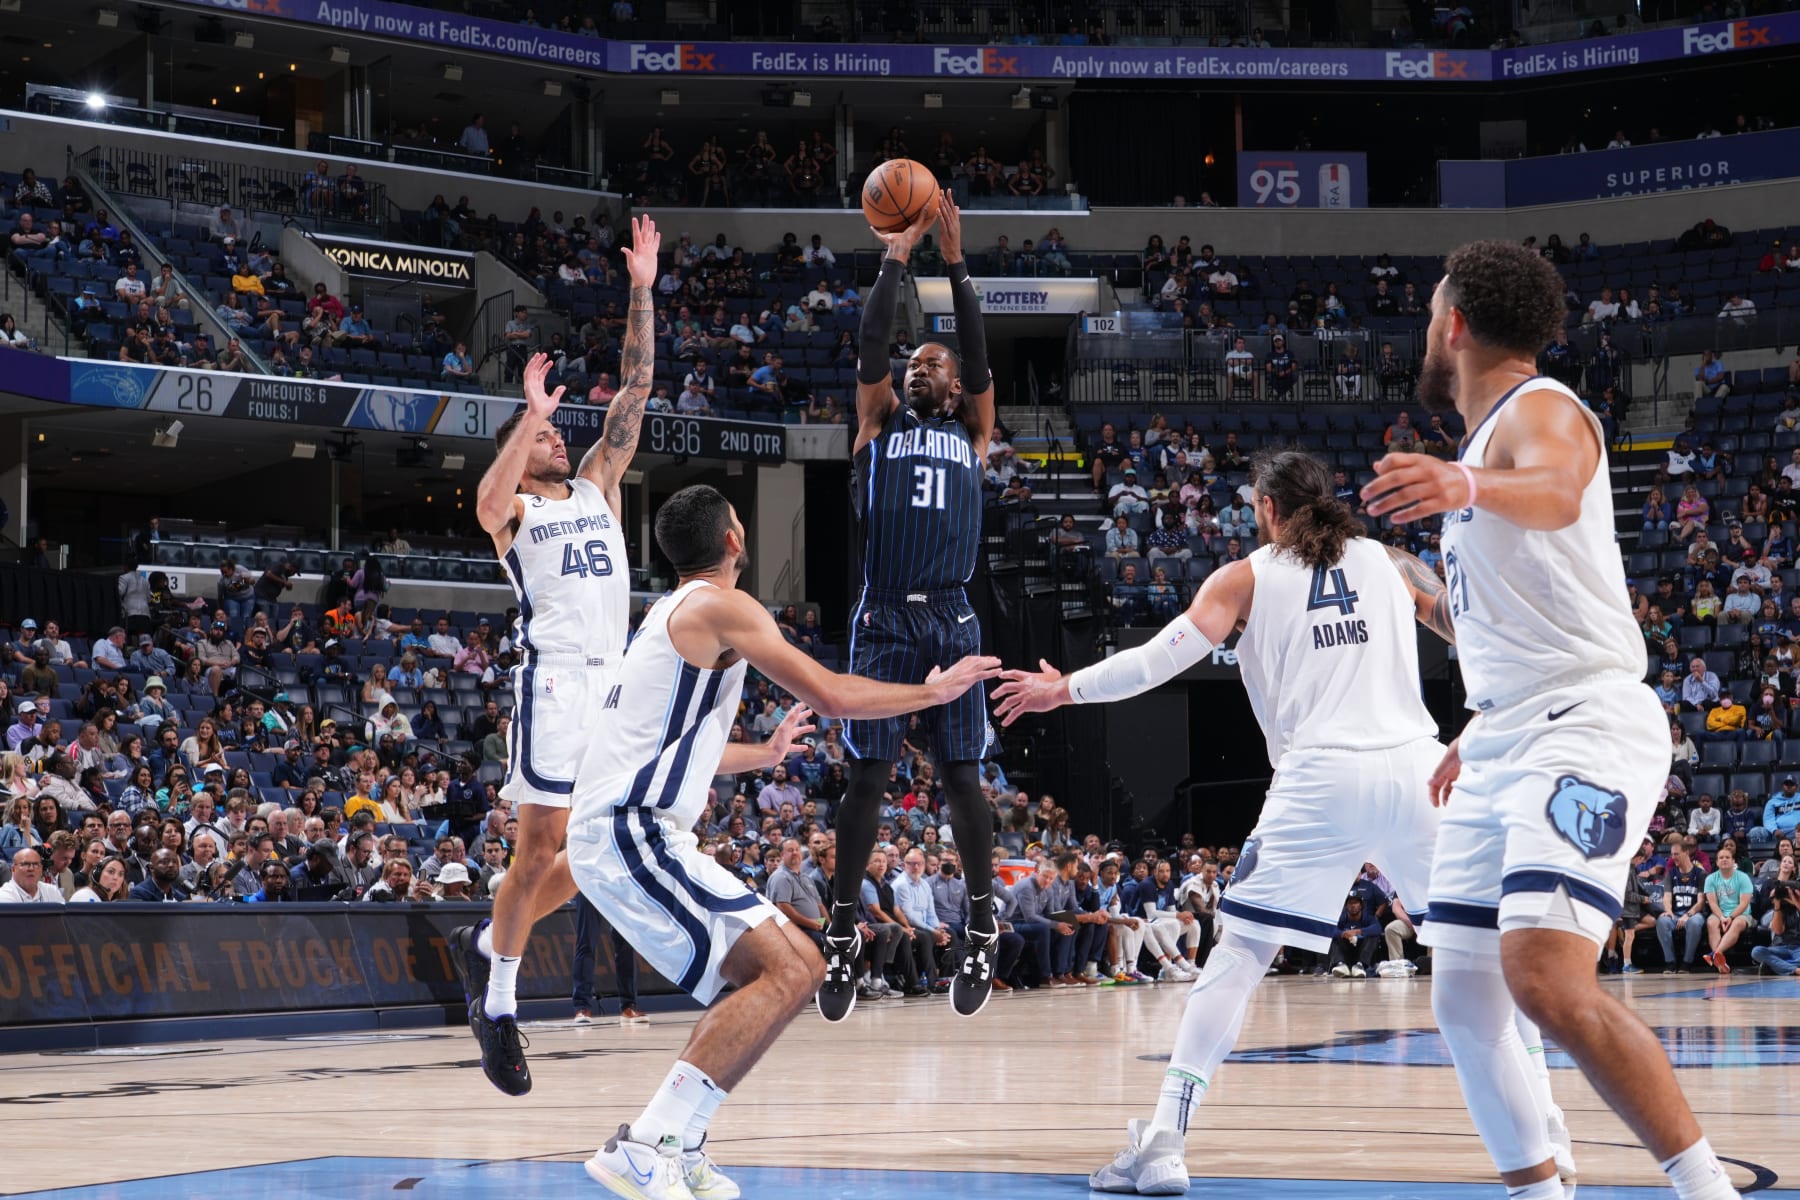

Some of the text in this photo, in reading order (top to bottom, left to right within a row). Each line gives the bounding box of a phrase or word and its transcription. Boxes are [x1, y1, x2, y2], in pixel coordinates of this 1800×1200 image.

[317, 1, 601, 66] Apply now at FedEx.com/careers
[1683, 21, 1770, 55] FedEx
[630, 44, 716, 71] FedEx
[752, 52, 890, 75] FedEx is Hiring
[934, 47, 1018, 74] FedEx
[1052, 56, 1348, 77] Apply now at FedEx.com/careers
[1386, 51, 1469, 78] FedEx
[1503, 45, 1639, 76] FedEx is Hiring
[1250, 169, 1300, 204] 95
[1607, 161, 1729, 187] SUPERIOR
[395, 256, 470, 280] MINOLTA
[986, 291, 1048, 304] LOTTERY
[986, 304, 1047, 312] TENNESSEE
[1093, 319, 1115, 331] 102
[177, 374, 213, 412] 26
[250, 382, 327, 404] TIMEOUTS: 6
[248, 401, 292, 421] FOULS:
[464, 400, 487, 436] 31
[591, 413, 599, 428] 6
[651, 417, 781, 455] 9:36 2ND QTR
[886, 427, 972, 469] ORLANDO
[911, 464, 946, 510] 31
[530, 513, 611, 544] MEMPHIS
[561, 539, 613, 579] 46
[1306, 563, 1359, 616] 4
[1312, 619, 1369, 650] ADAMS
[0, 942, 211, 999] OFFICIAL
[218, 937, 362, 990] TRUCK
[371, 936, 417, 985] OF
